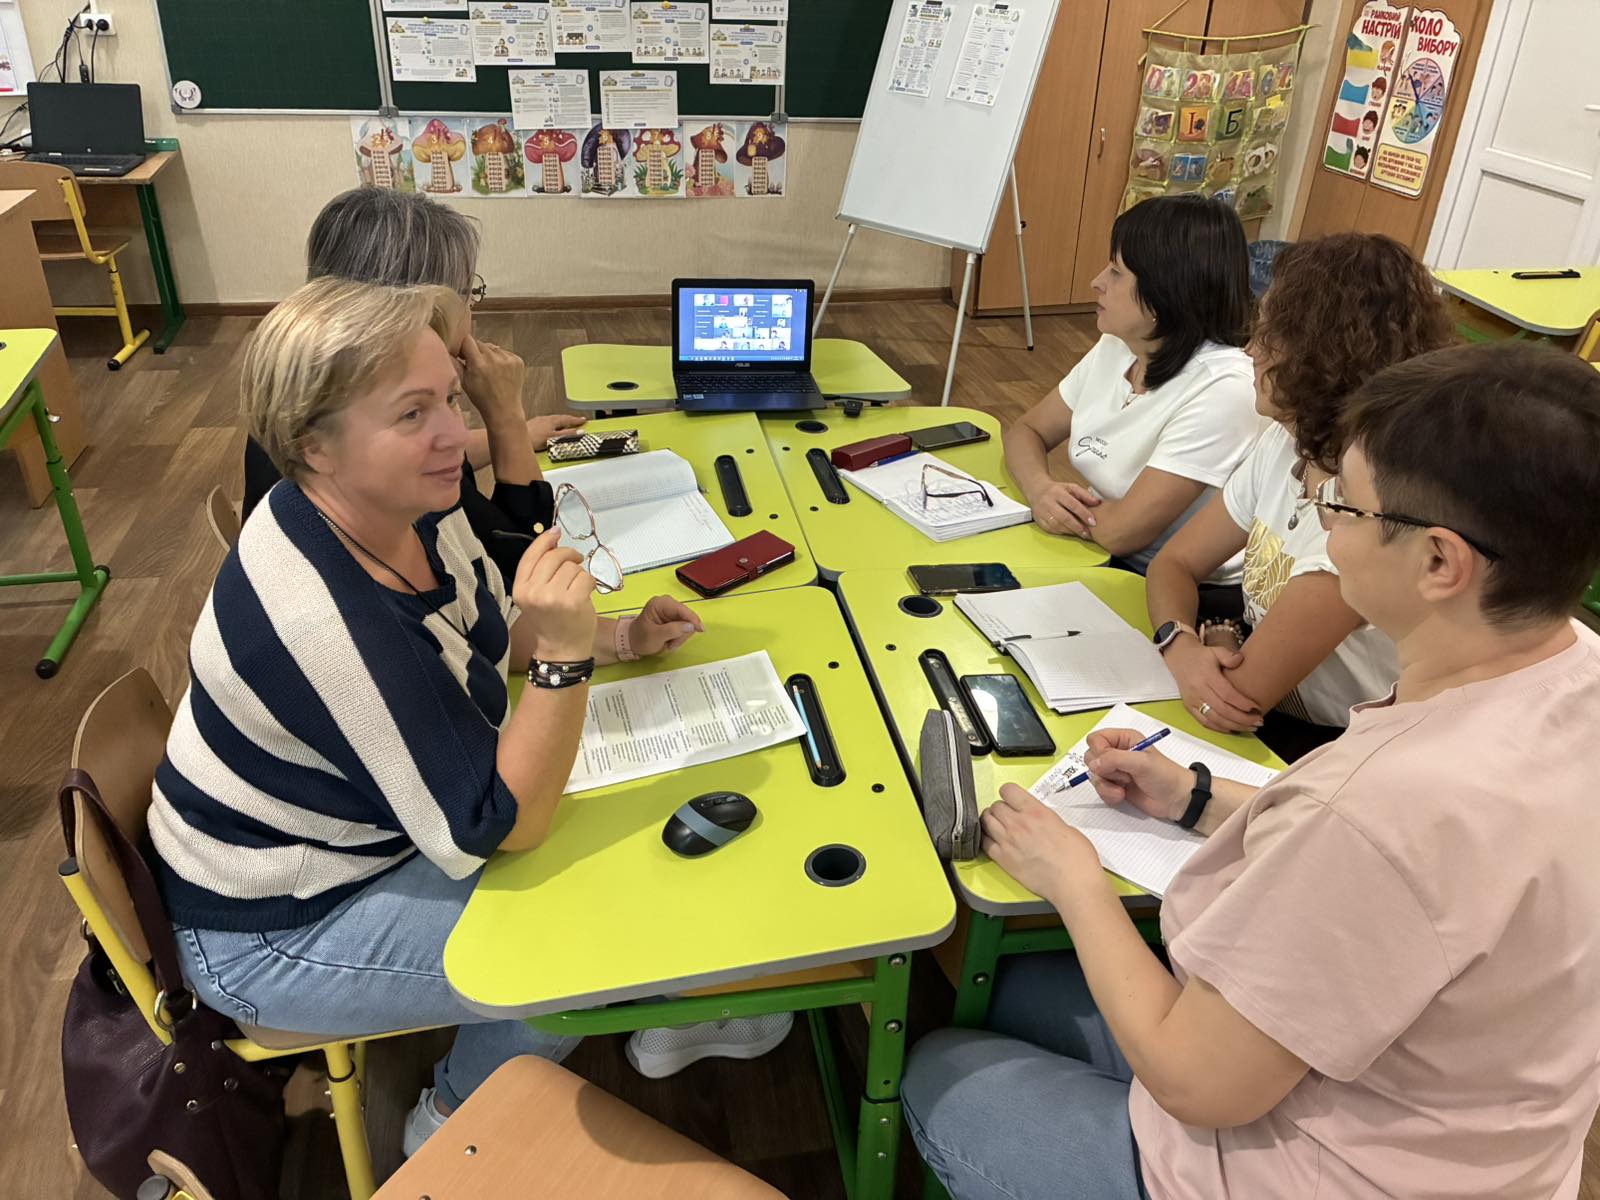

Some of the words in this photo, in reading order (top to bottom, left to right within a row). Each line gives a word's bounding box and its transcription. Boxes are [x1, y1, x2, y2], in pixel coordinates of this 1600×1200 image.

[1361, 19, 1402, 39] НАСТРІЙ
[1411, 15, 1443, 36] КОЛО
[1417, 37, 1457, 57] ВИБОРУ
[1225, 109, 1243, 135] Б
